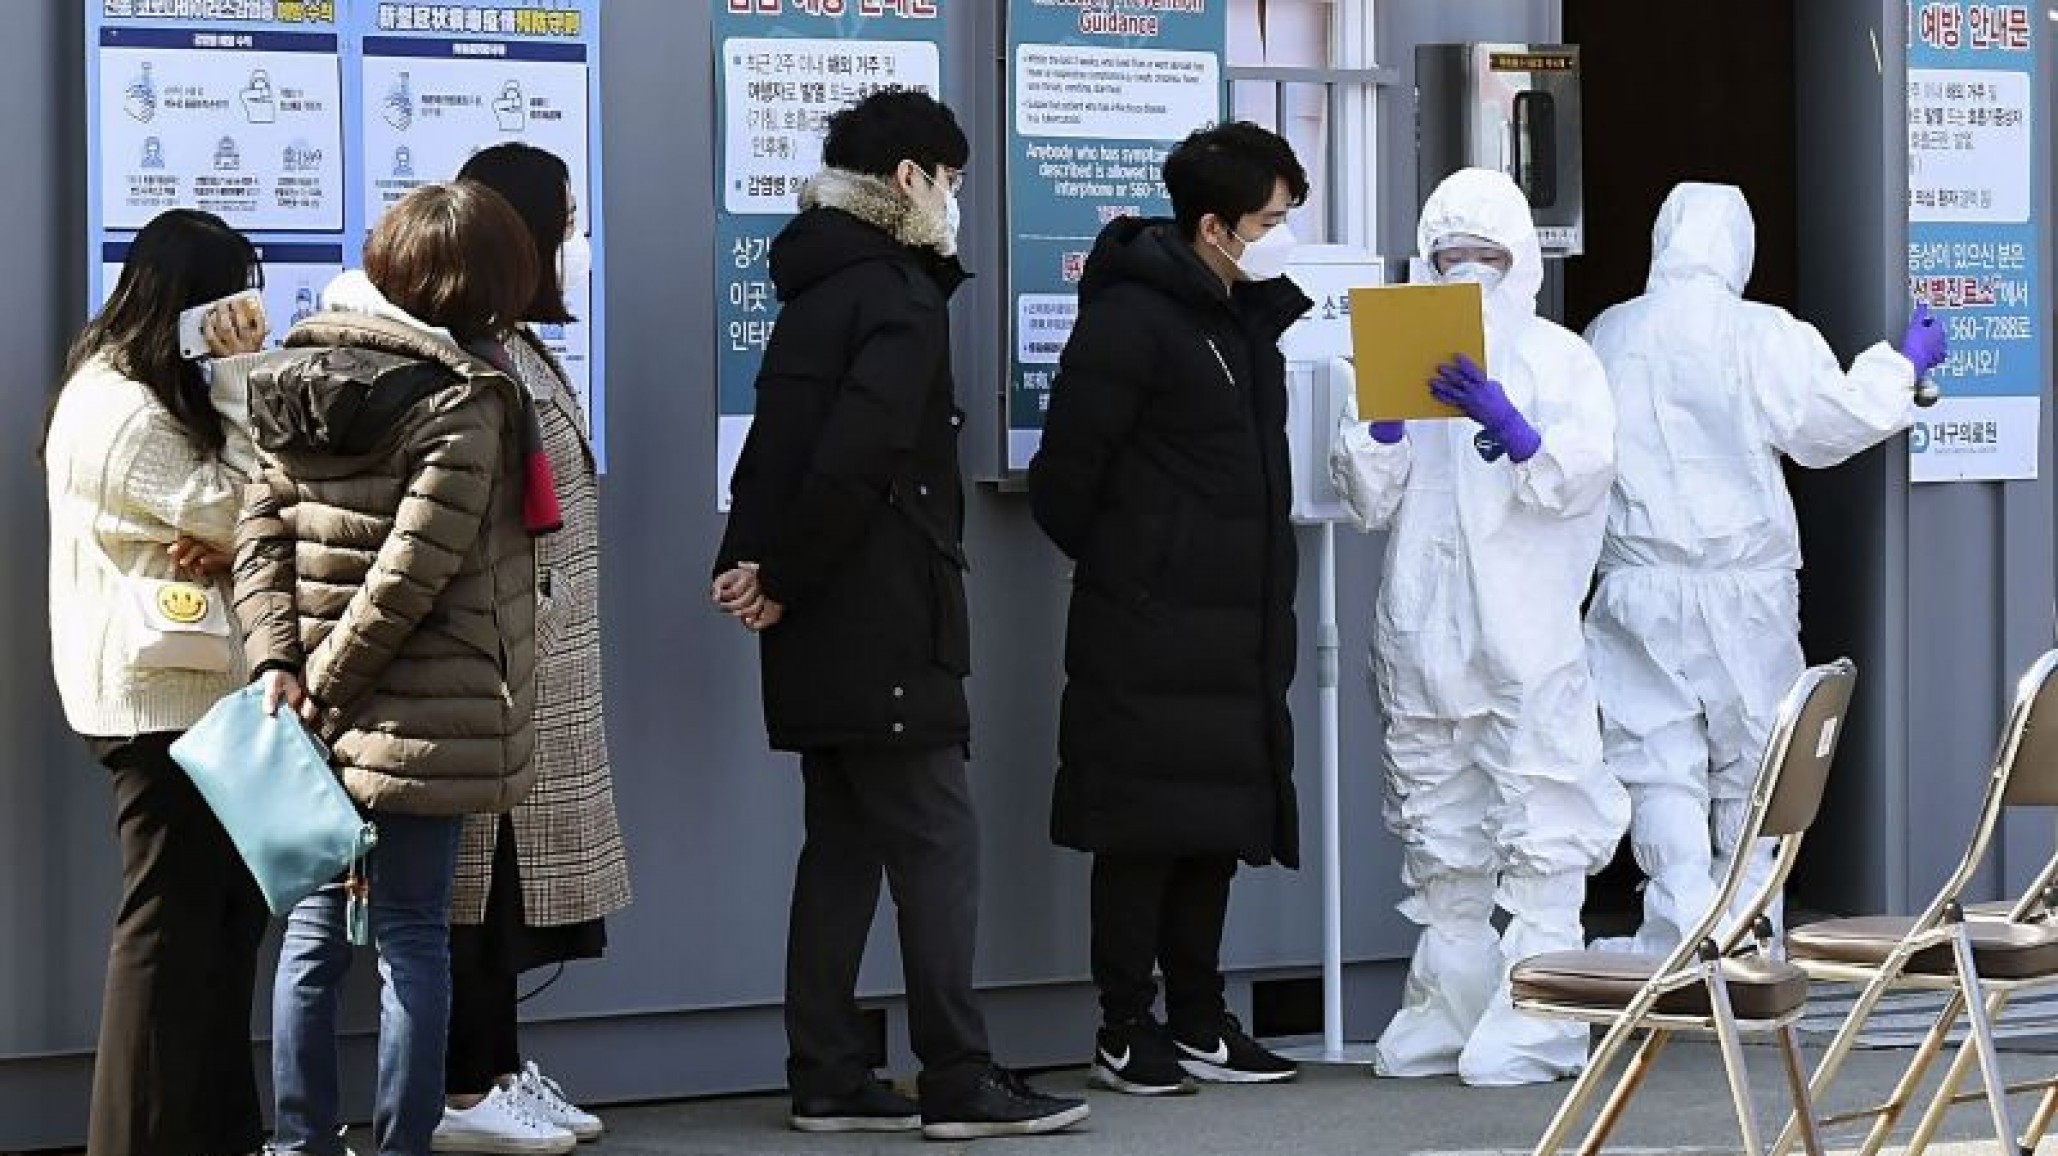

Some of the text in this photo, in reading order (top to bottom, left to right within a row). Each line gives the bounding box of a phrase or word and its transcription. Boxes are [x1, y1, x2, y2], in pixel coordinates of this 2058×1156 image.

[1079, 11, 1158, 36] Guidance
[1920, 4, 2030, 49] 예방 안내문
[1077, 147, 1097, 160] who
[1100, 145, 1120, 161] has
[1039, 162, 1092, 178] described
[1107, 166, 1147, 179] allowed
[732, 237, 770, 269] 상기
[1998, 243, 2025, 269] 분은
[730, 281, 767, 312] 이곳
[1929, 350, 1999, 377] 십시오!
[1934, 420, 1997, 444] 대구의료원
